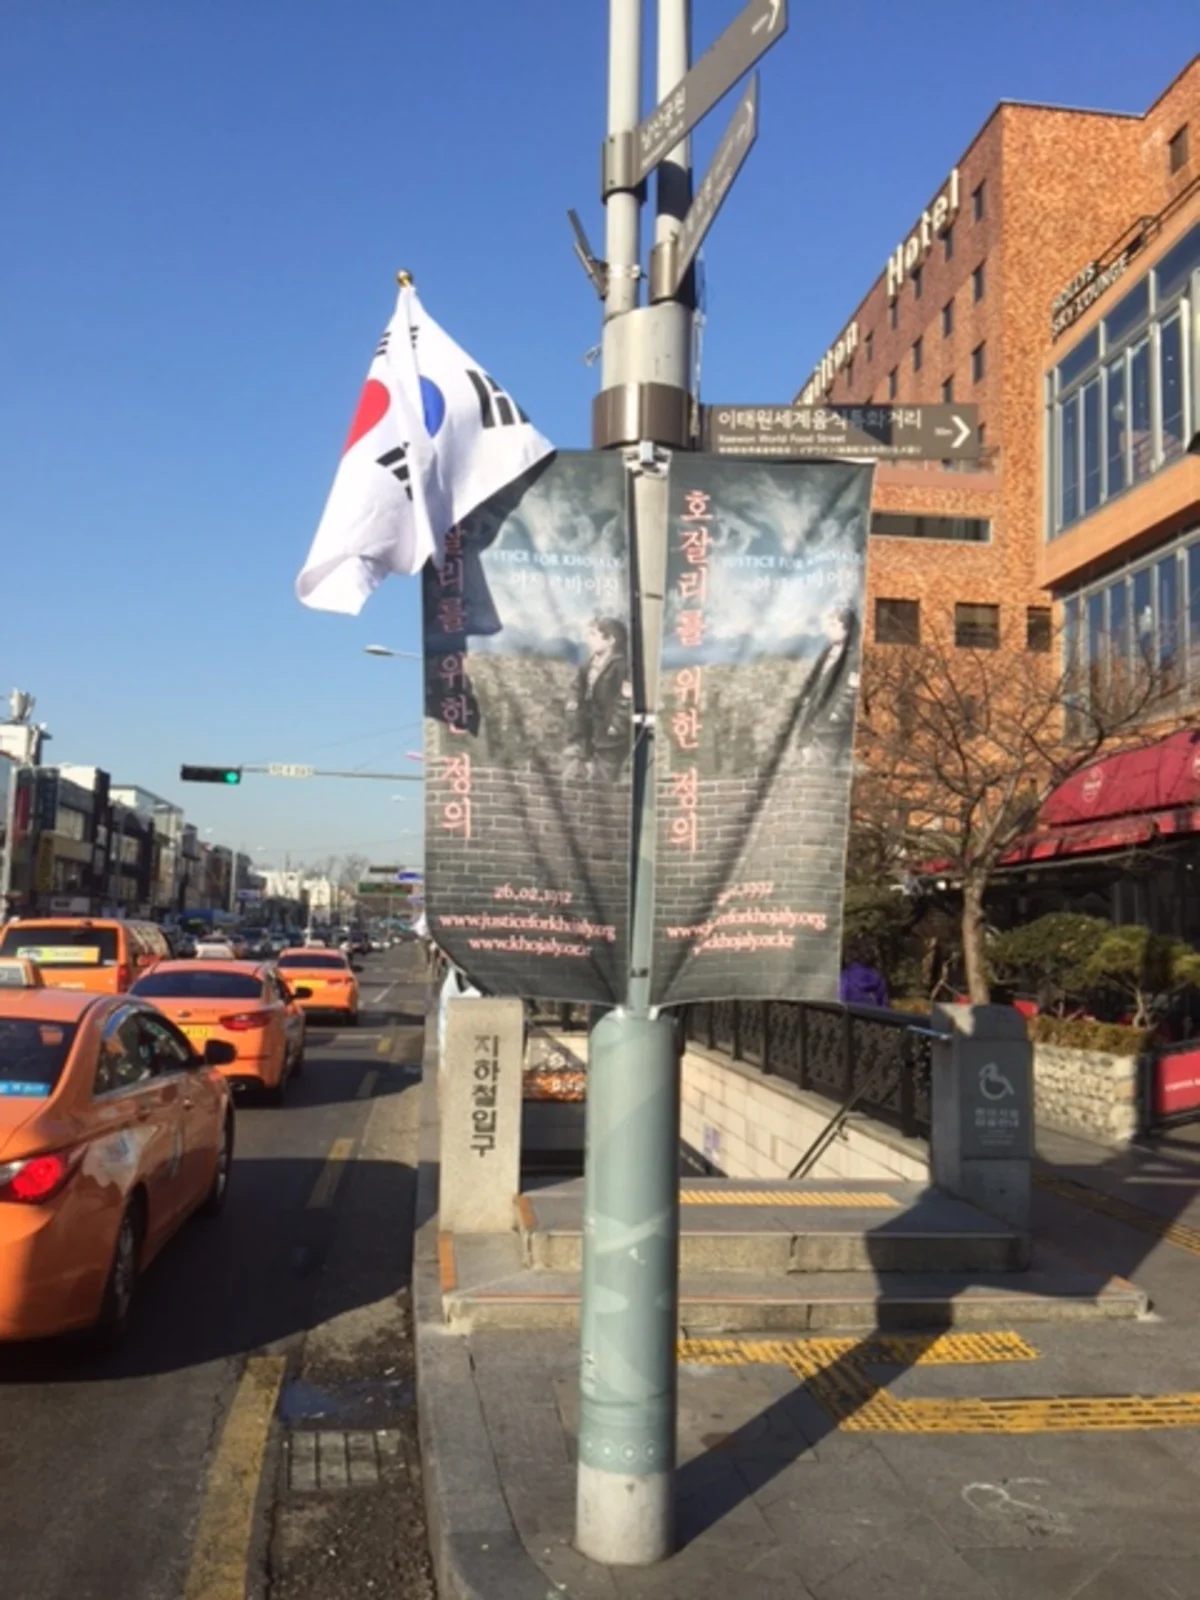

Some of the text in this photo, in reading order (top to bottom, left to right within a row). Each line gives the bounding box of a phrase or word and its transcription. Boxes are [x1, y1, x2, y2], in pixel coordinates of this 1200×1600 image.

[887, 168, 959, 296] Hotel
[759, 434, 787, 444] World
[790, 434, 814, 444] Food
[817, 434, 846, 444] Street
[441, 652, 473, 735] 위한
[670, 490, 714, 853] 호잘리를 위한 정의
[440, 752, 471, 840] 정의
[470, 1035, 500, 1158] 지하철입구
